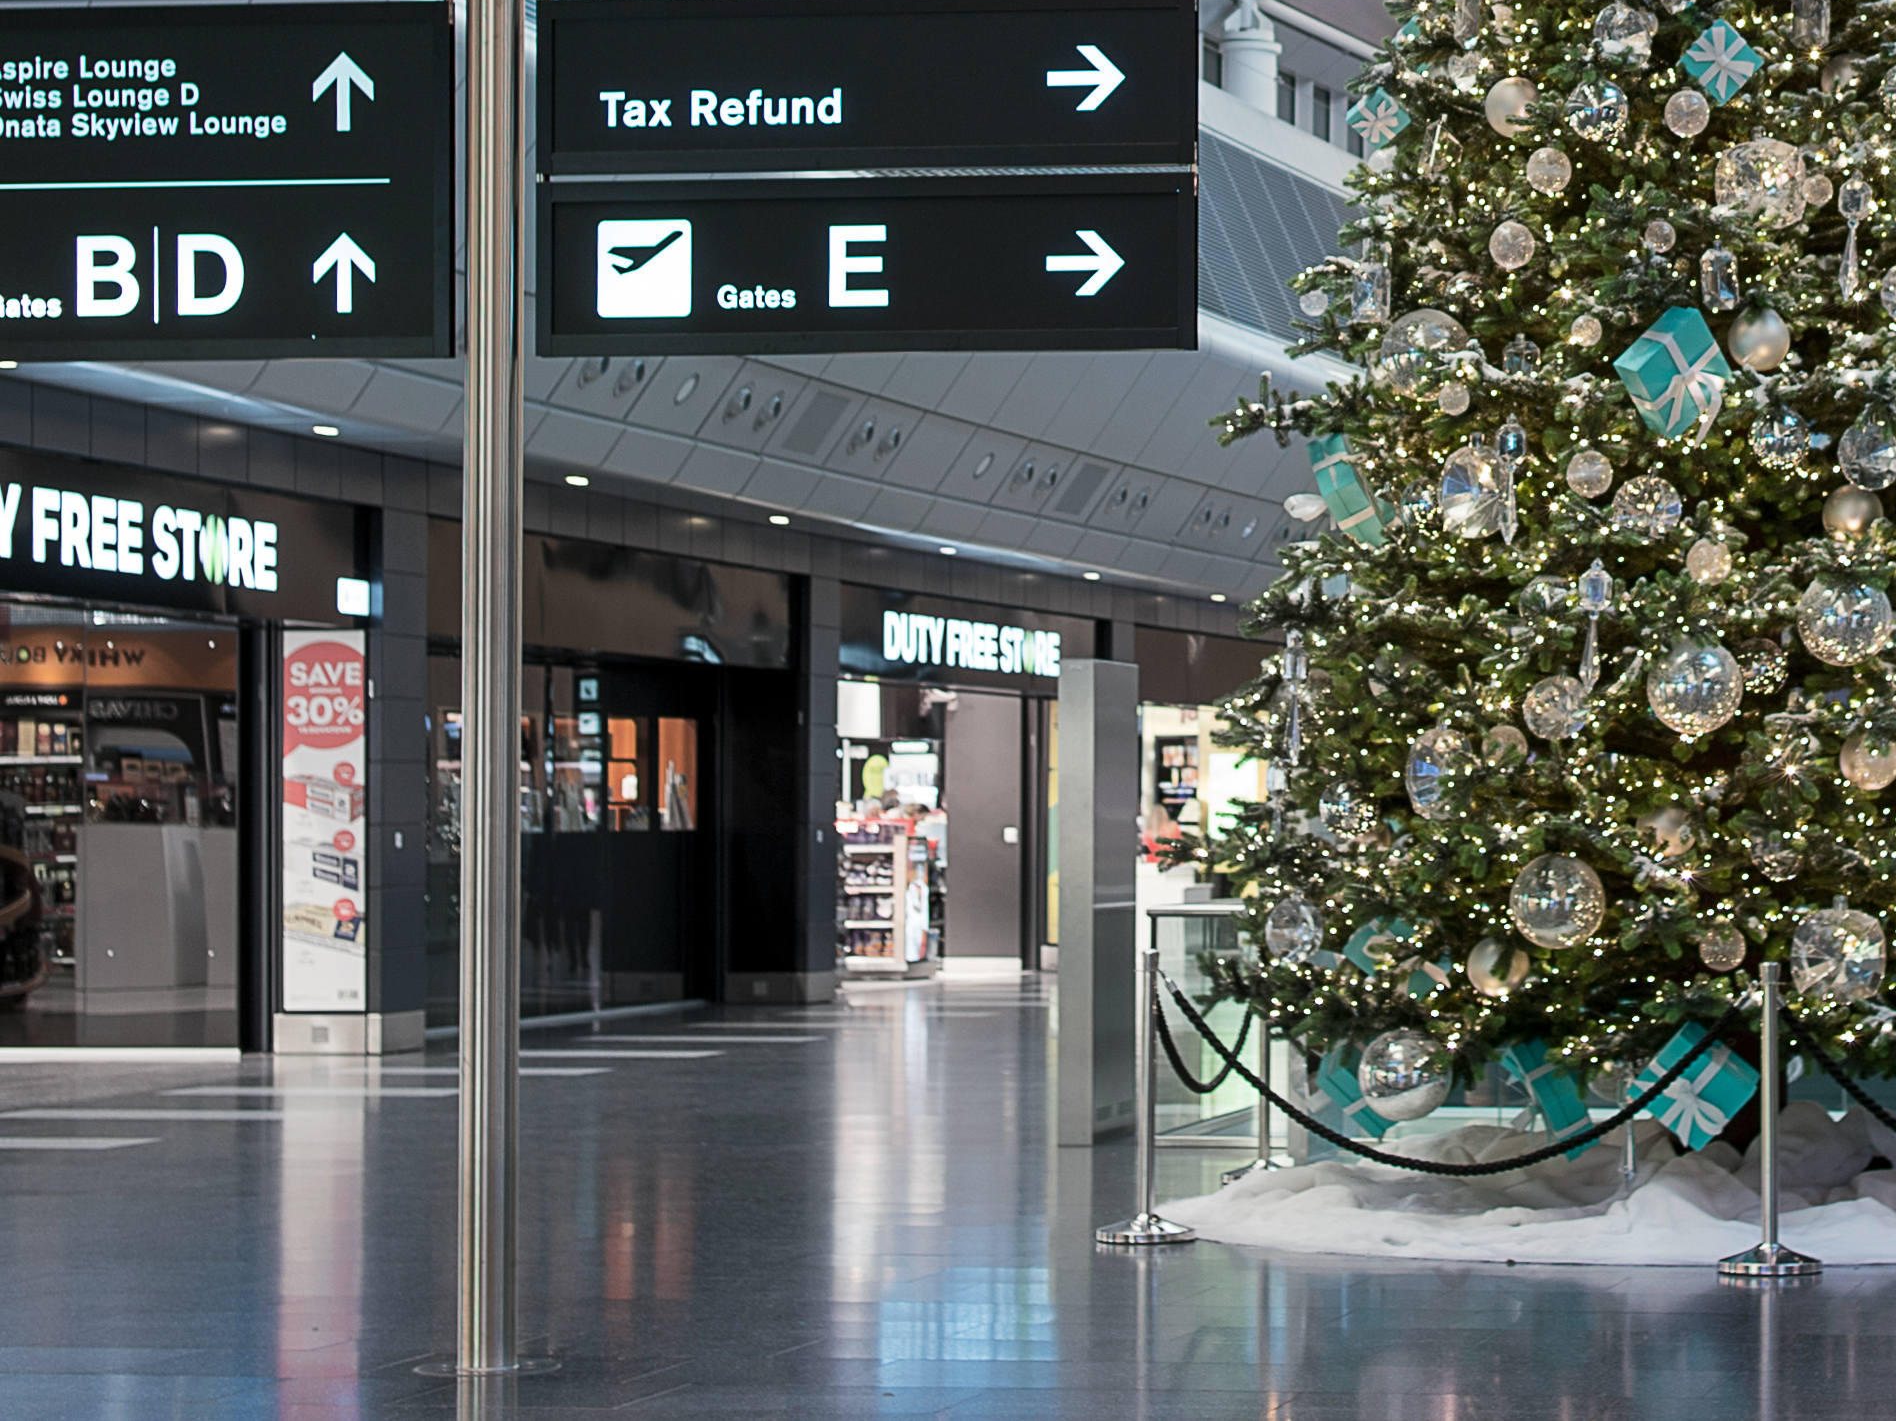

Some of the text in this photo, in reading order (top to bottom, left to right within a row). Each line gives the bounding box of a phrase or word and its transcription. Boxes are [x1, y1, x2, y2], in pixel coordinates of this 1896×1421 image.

[0, 55, 177, 85] spire Lounge
[0, 83, 200, 112] wiss Lounge D
[599, 88, 842, 128] Tax Refund
[72, 113, 179, 140] Skyview
[190, 112, 287, 138] Lounge
[717, 224, 889, 310] Gates E
[32, 486, 144, 575] FREE
[152, 505, 278, 592] STORE
[883, 610, 1061, 677] DUTY FREE STORE
[289, 661, 362, 687] SAVE
[286, 694, 365, 726] 30%
